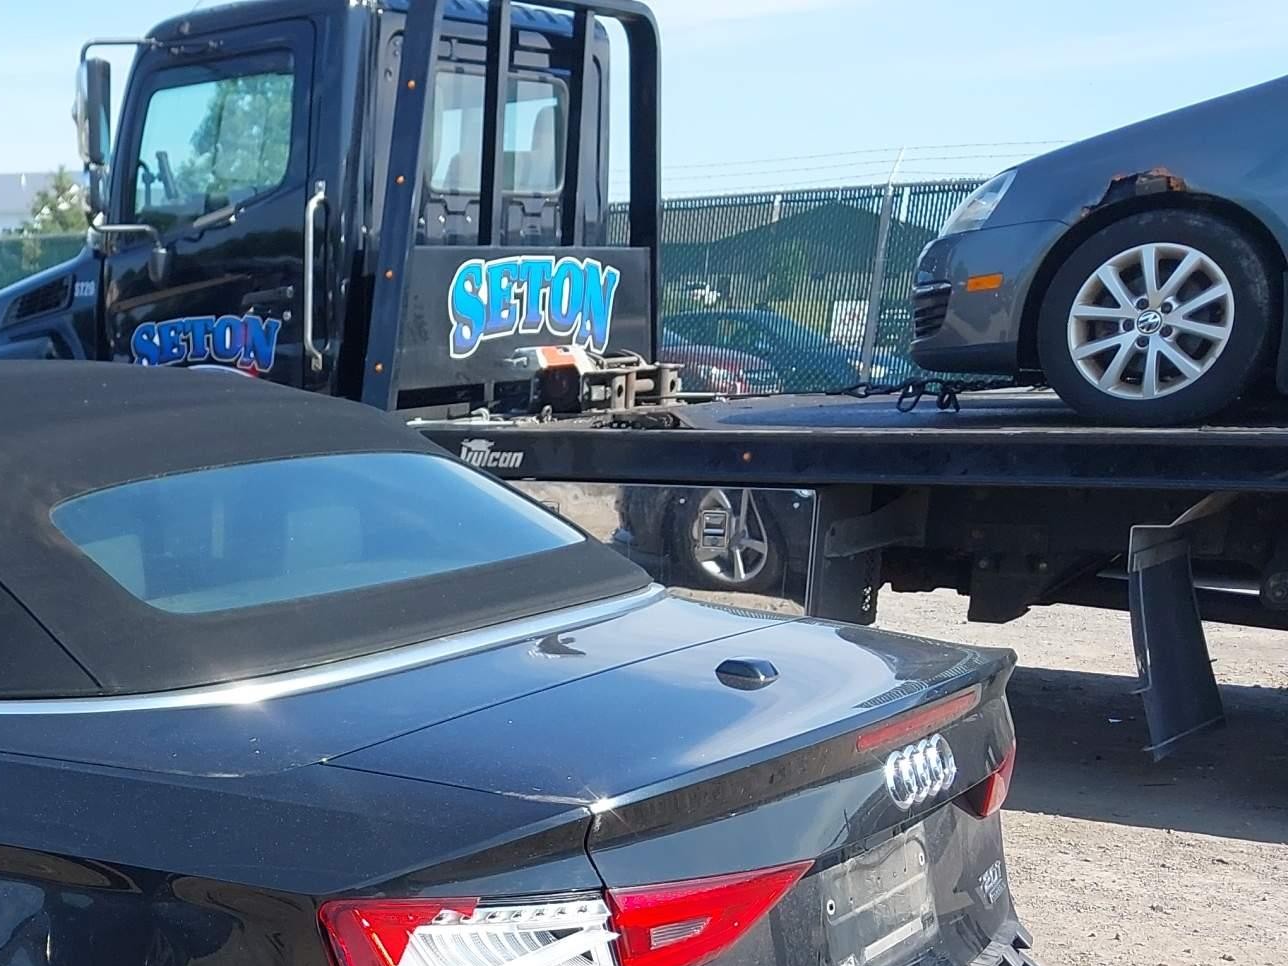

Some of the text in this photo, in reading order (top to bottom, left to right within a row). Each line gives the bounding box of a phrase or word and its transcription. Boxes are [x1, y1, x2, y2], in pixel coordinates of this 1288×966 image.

[448, 255, 620, 359] SETON
[131, 314, 282, 373] SETON
[460, 445, 524, 468] Vulcan
